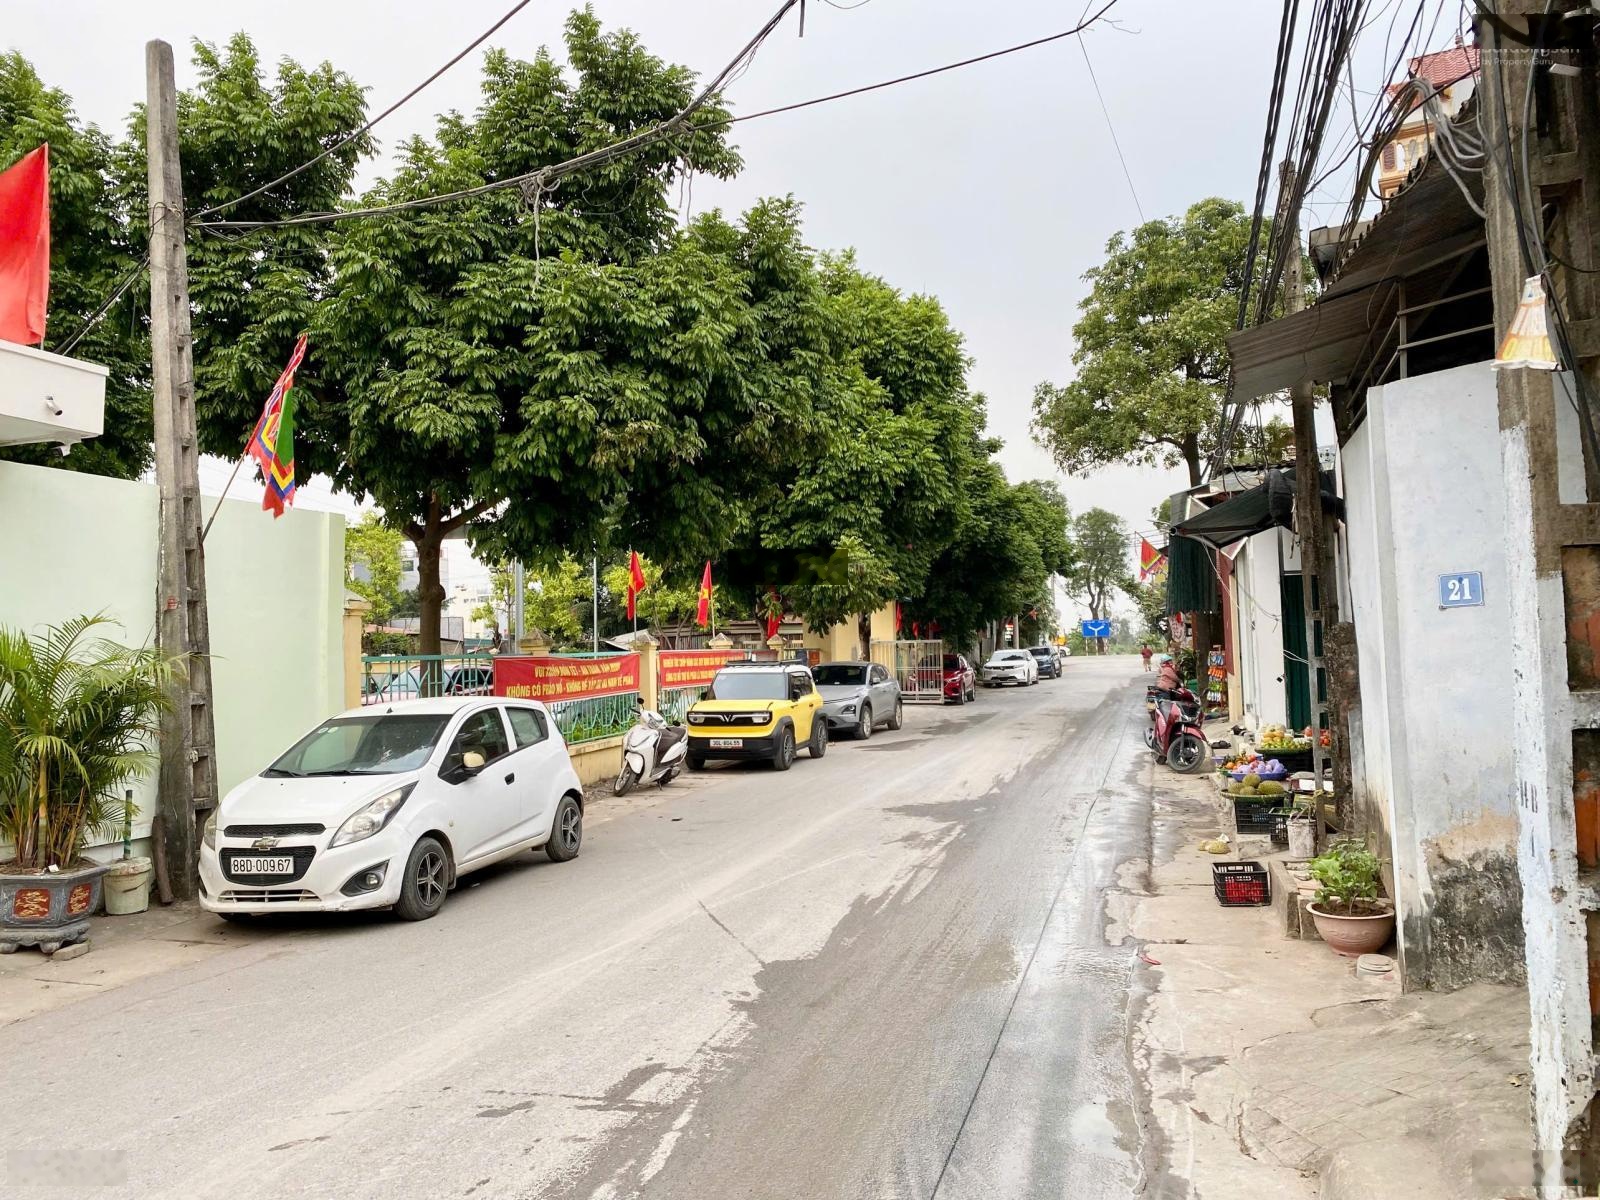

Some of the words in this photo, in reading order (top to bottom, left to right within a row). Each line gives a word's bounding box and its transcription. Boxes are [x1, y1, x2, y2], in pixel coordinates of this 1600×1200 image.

[1448, 577, 1472, 600] 21
[506, 683, 530, 698] KHÔNG
[532, 682, 542, 697] CÓ
[234, 859, 290, 872] 88D-009.67
